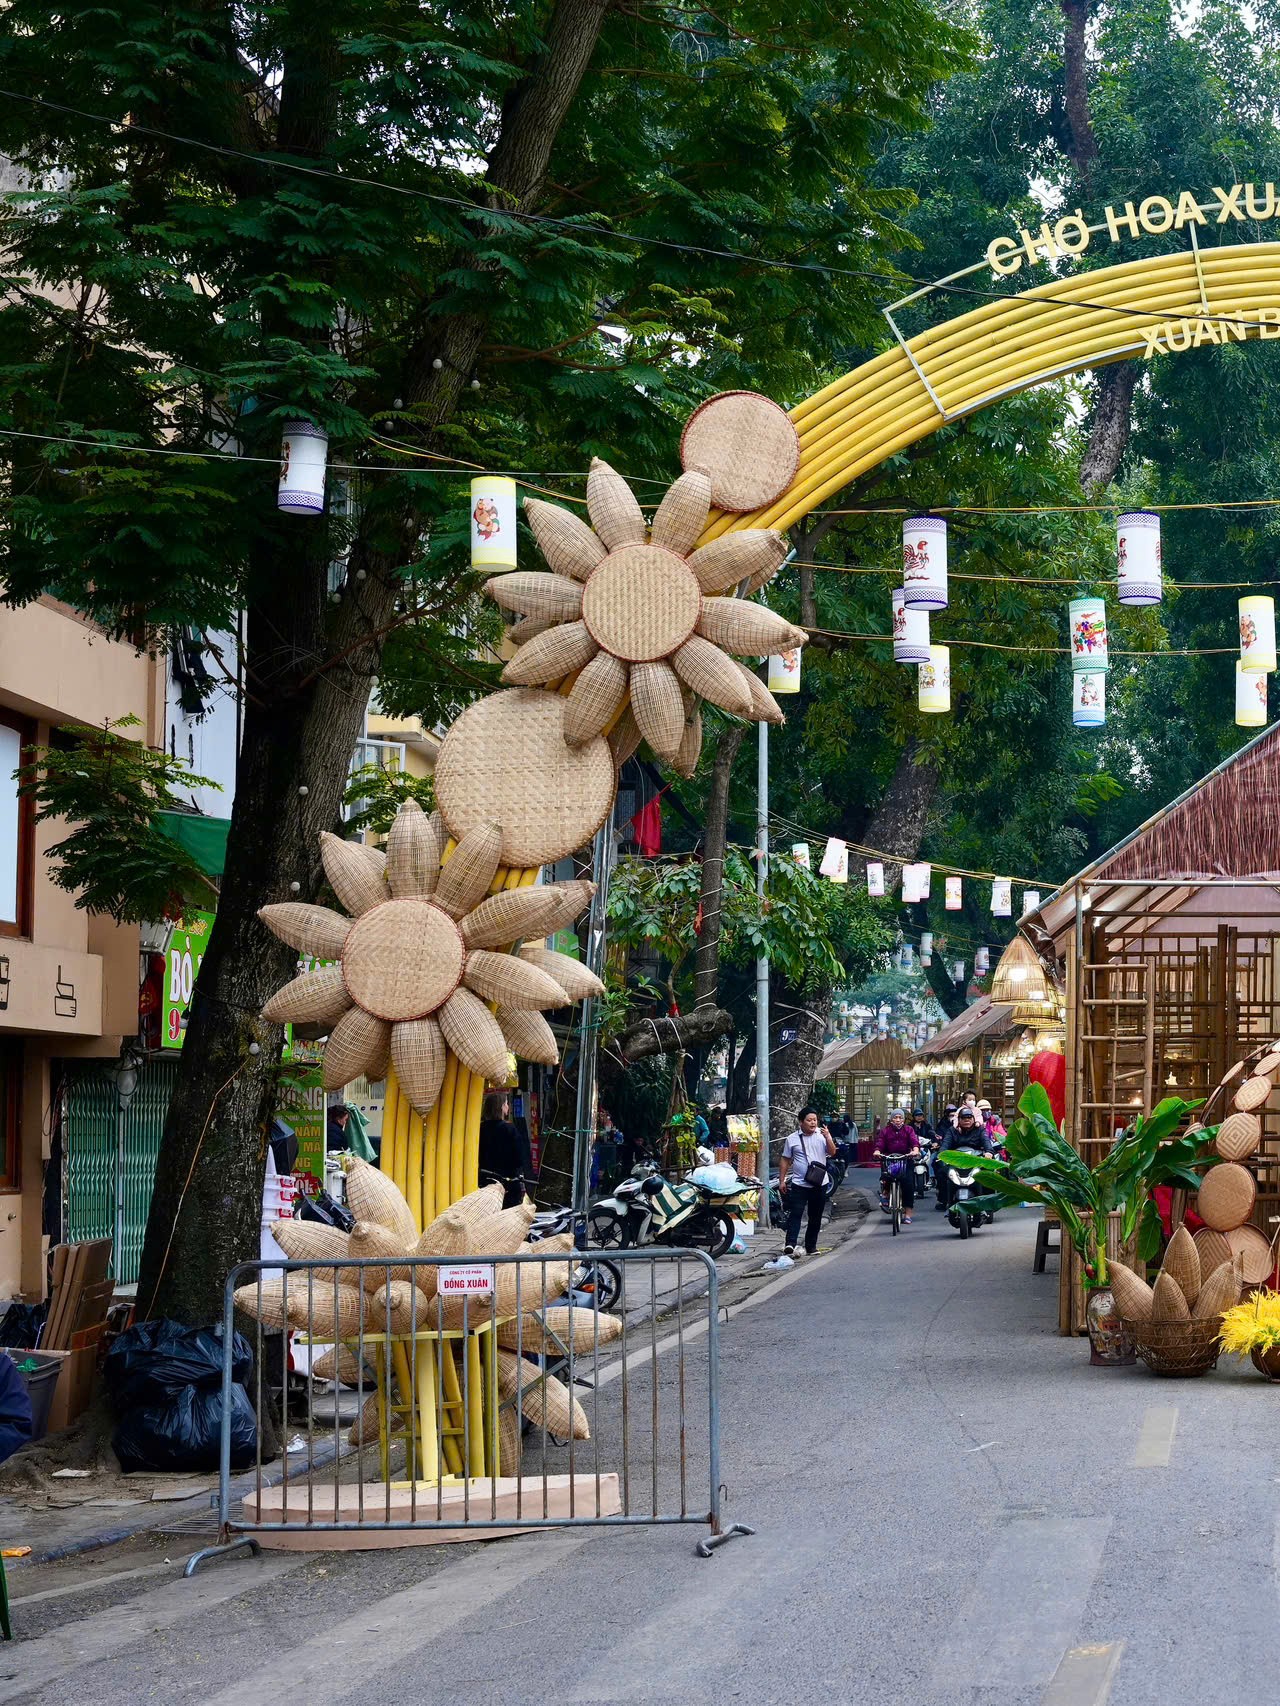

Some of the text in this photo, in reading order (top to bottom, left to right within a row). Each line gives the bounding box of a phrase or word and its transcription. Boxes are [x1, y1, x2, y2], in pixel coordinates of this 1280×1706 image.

[987, 208, 1090, 275] CHỢ
[1104, 191, 1207, 242] HOA
[1137, 305, 1248, 359] XUÂN
[467, 1277, 488, 1288] XUÂN
